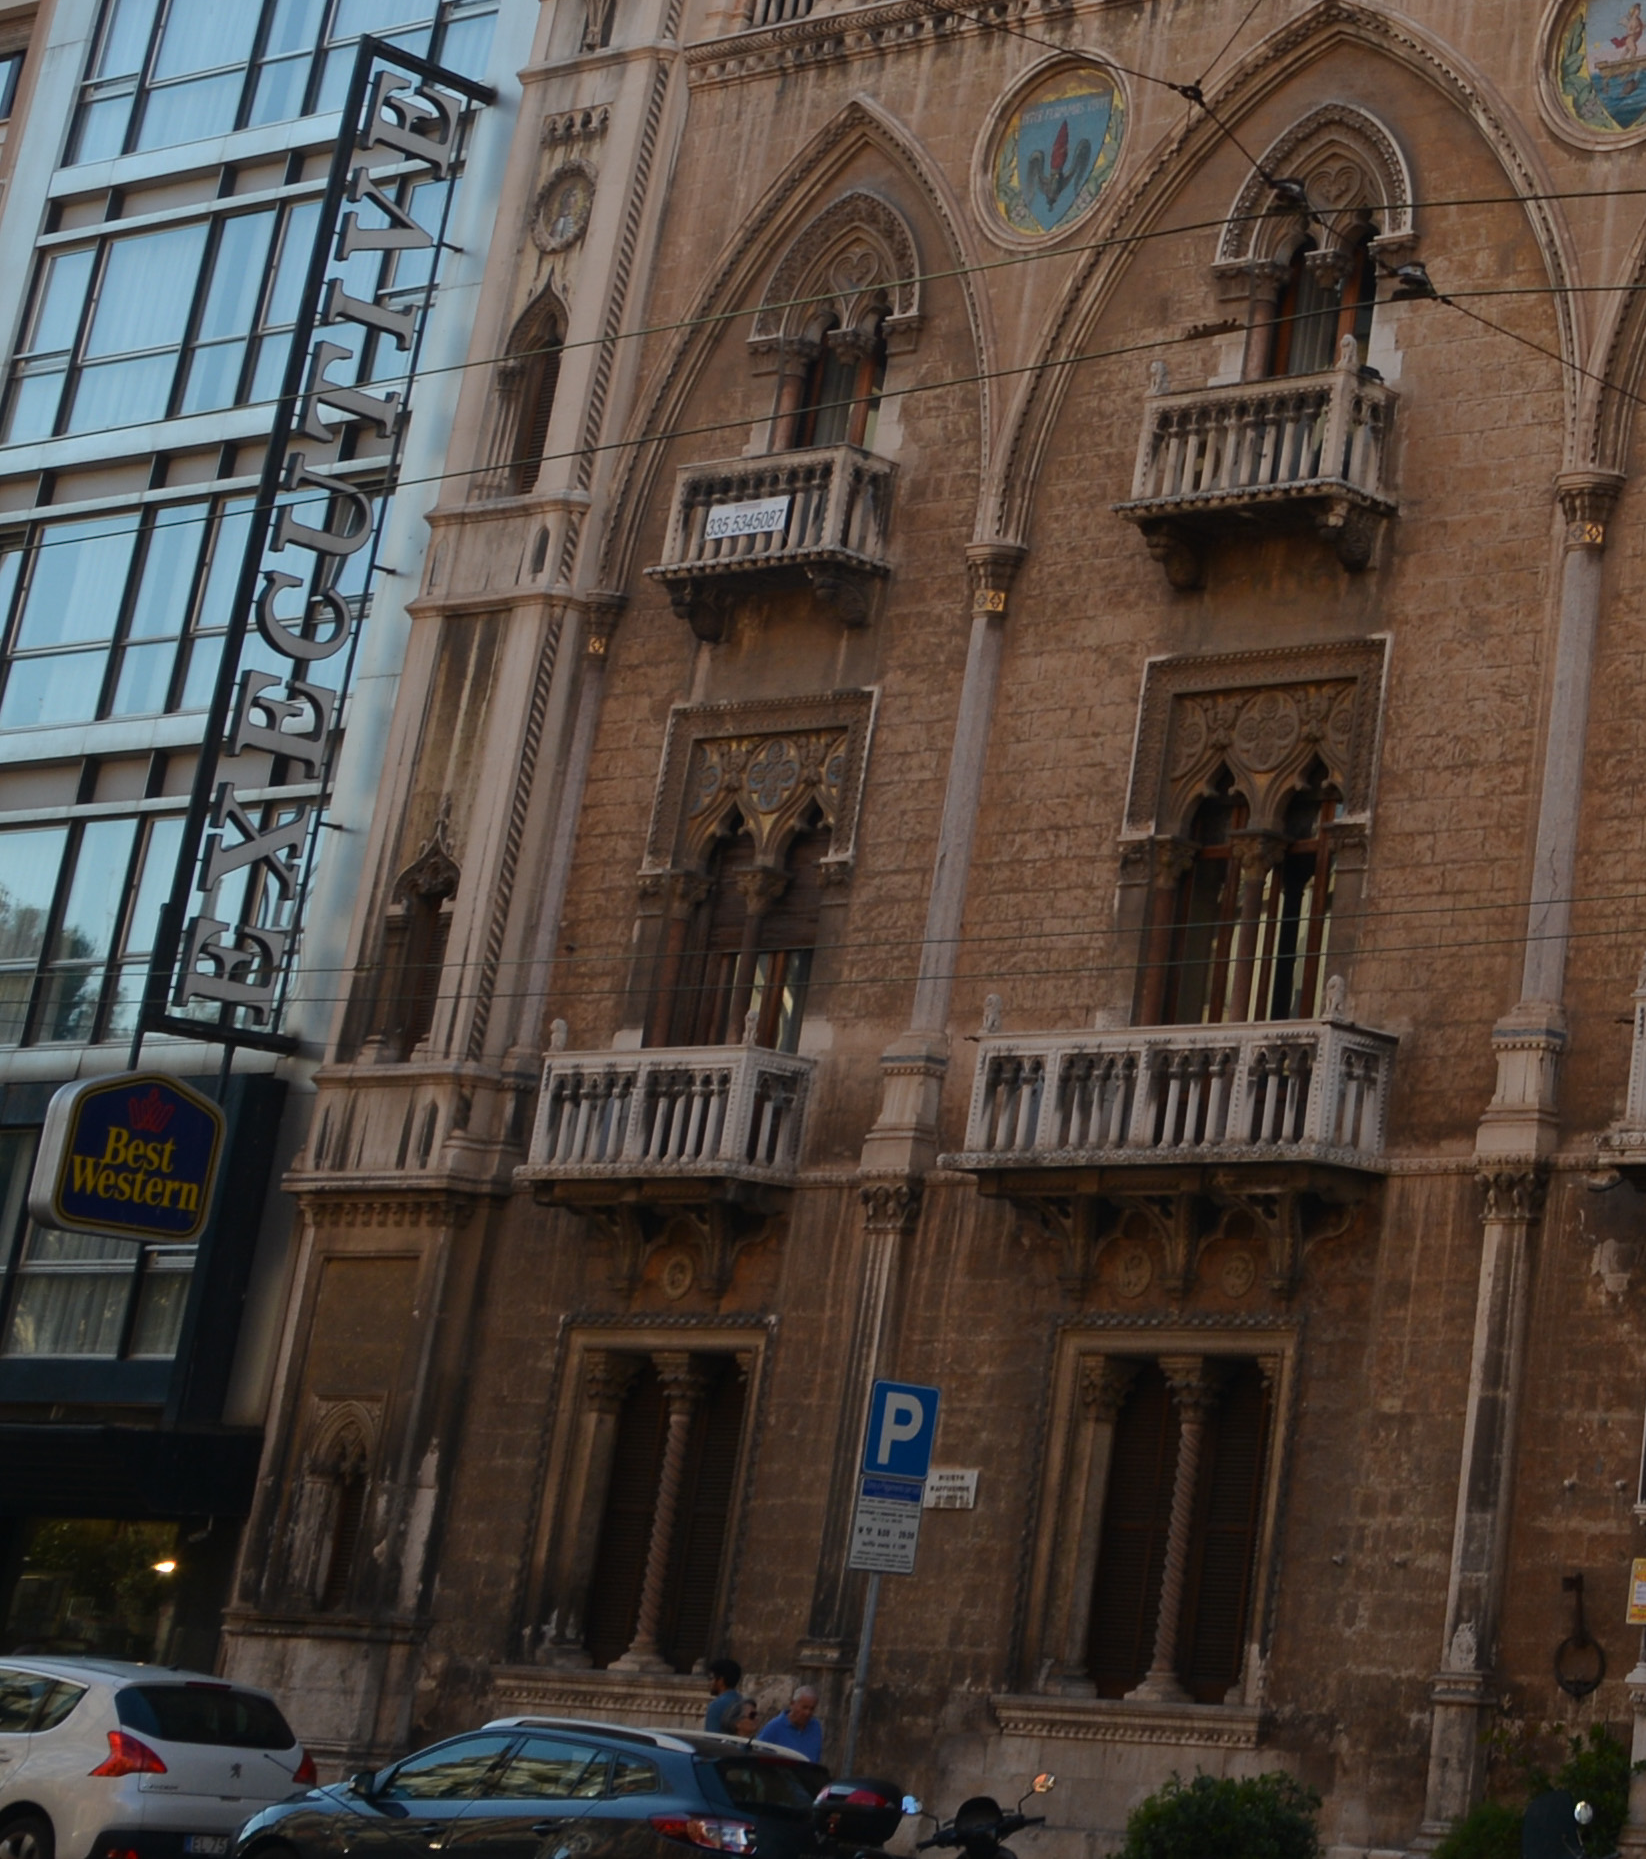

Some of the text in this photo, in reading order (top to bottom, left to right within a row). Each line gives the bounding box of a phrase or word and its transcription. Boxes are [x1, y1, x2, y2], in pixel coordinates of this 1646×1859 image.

[173, 70, 462, 1025] EXECUTIVE
[706, 508, 785, 537] 335 5345087
[103, 1125, 177, 1174] Best
[73, 1154, 199, 1212] Western
[877, 1391, 923, 1465] P
